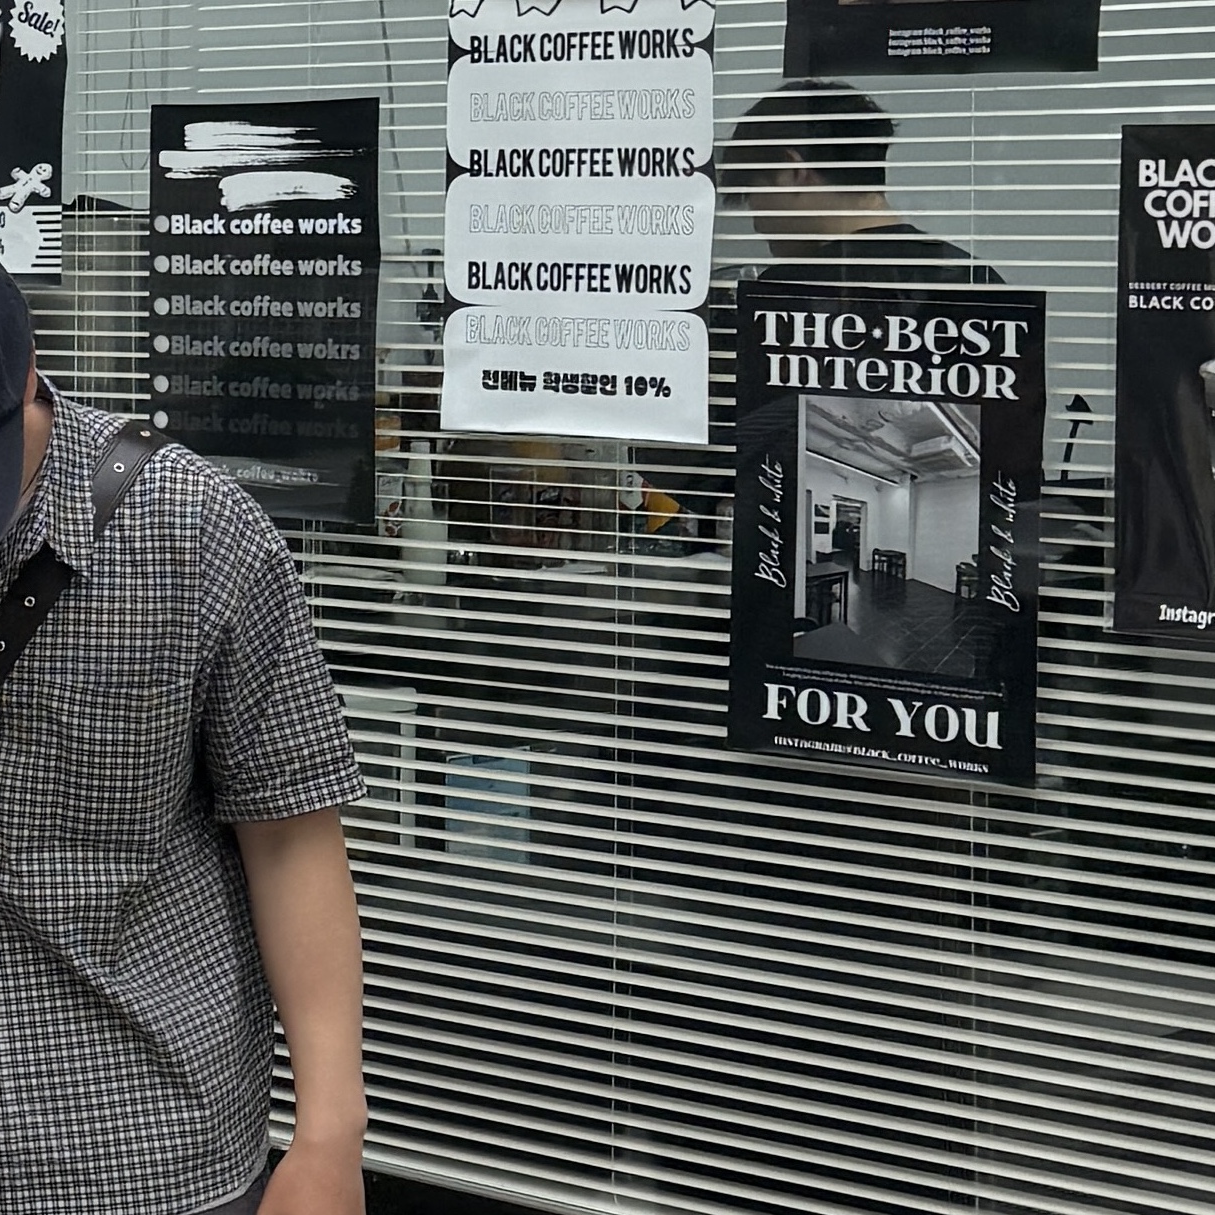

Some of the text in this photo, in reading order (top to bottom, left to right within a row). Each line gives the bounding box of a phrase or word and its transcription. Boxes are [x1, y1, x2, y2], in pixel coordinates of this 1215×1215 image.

[18, 1, 60, 38] Sale!
[470, 28, 695, 64] BLACK COFFEE WORKS
[470, 88, 695, 122] BLACK COFFEE WORKS
[469, 147, 695, 178] BLACK COFFEE WORKS
[1138, 158, 1215, 188] BLAC
[171, 213, 362, 235] Black coffee works
[469, 204, 695, 236] BLACK COFFEE WORKS
[1156, 219, 1215, 249] WO
[171, 254, 362, 277] Black coffee works
[467, 261, 692, 295] BLACK COFFEE WORKS
[171, 295, 362, 319] Black coffee works
[1128, 295, 1215, 311] BLACK CO
[171, 335, 361, 361] Black coffee wokrs
[466, 314, 691, 351] BLACK COFFEE WORKS
[170, 374, 224, 397] Black
[228, 376, 293, 400] coffee
[482, 370, 672, 398] 전메뉴 학생할인 10%
[754, 525, 787, 588] Black
[986, 545, 1021, 613] Black
[762, 682, 1003, 750] FOR YOU
